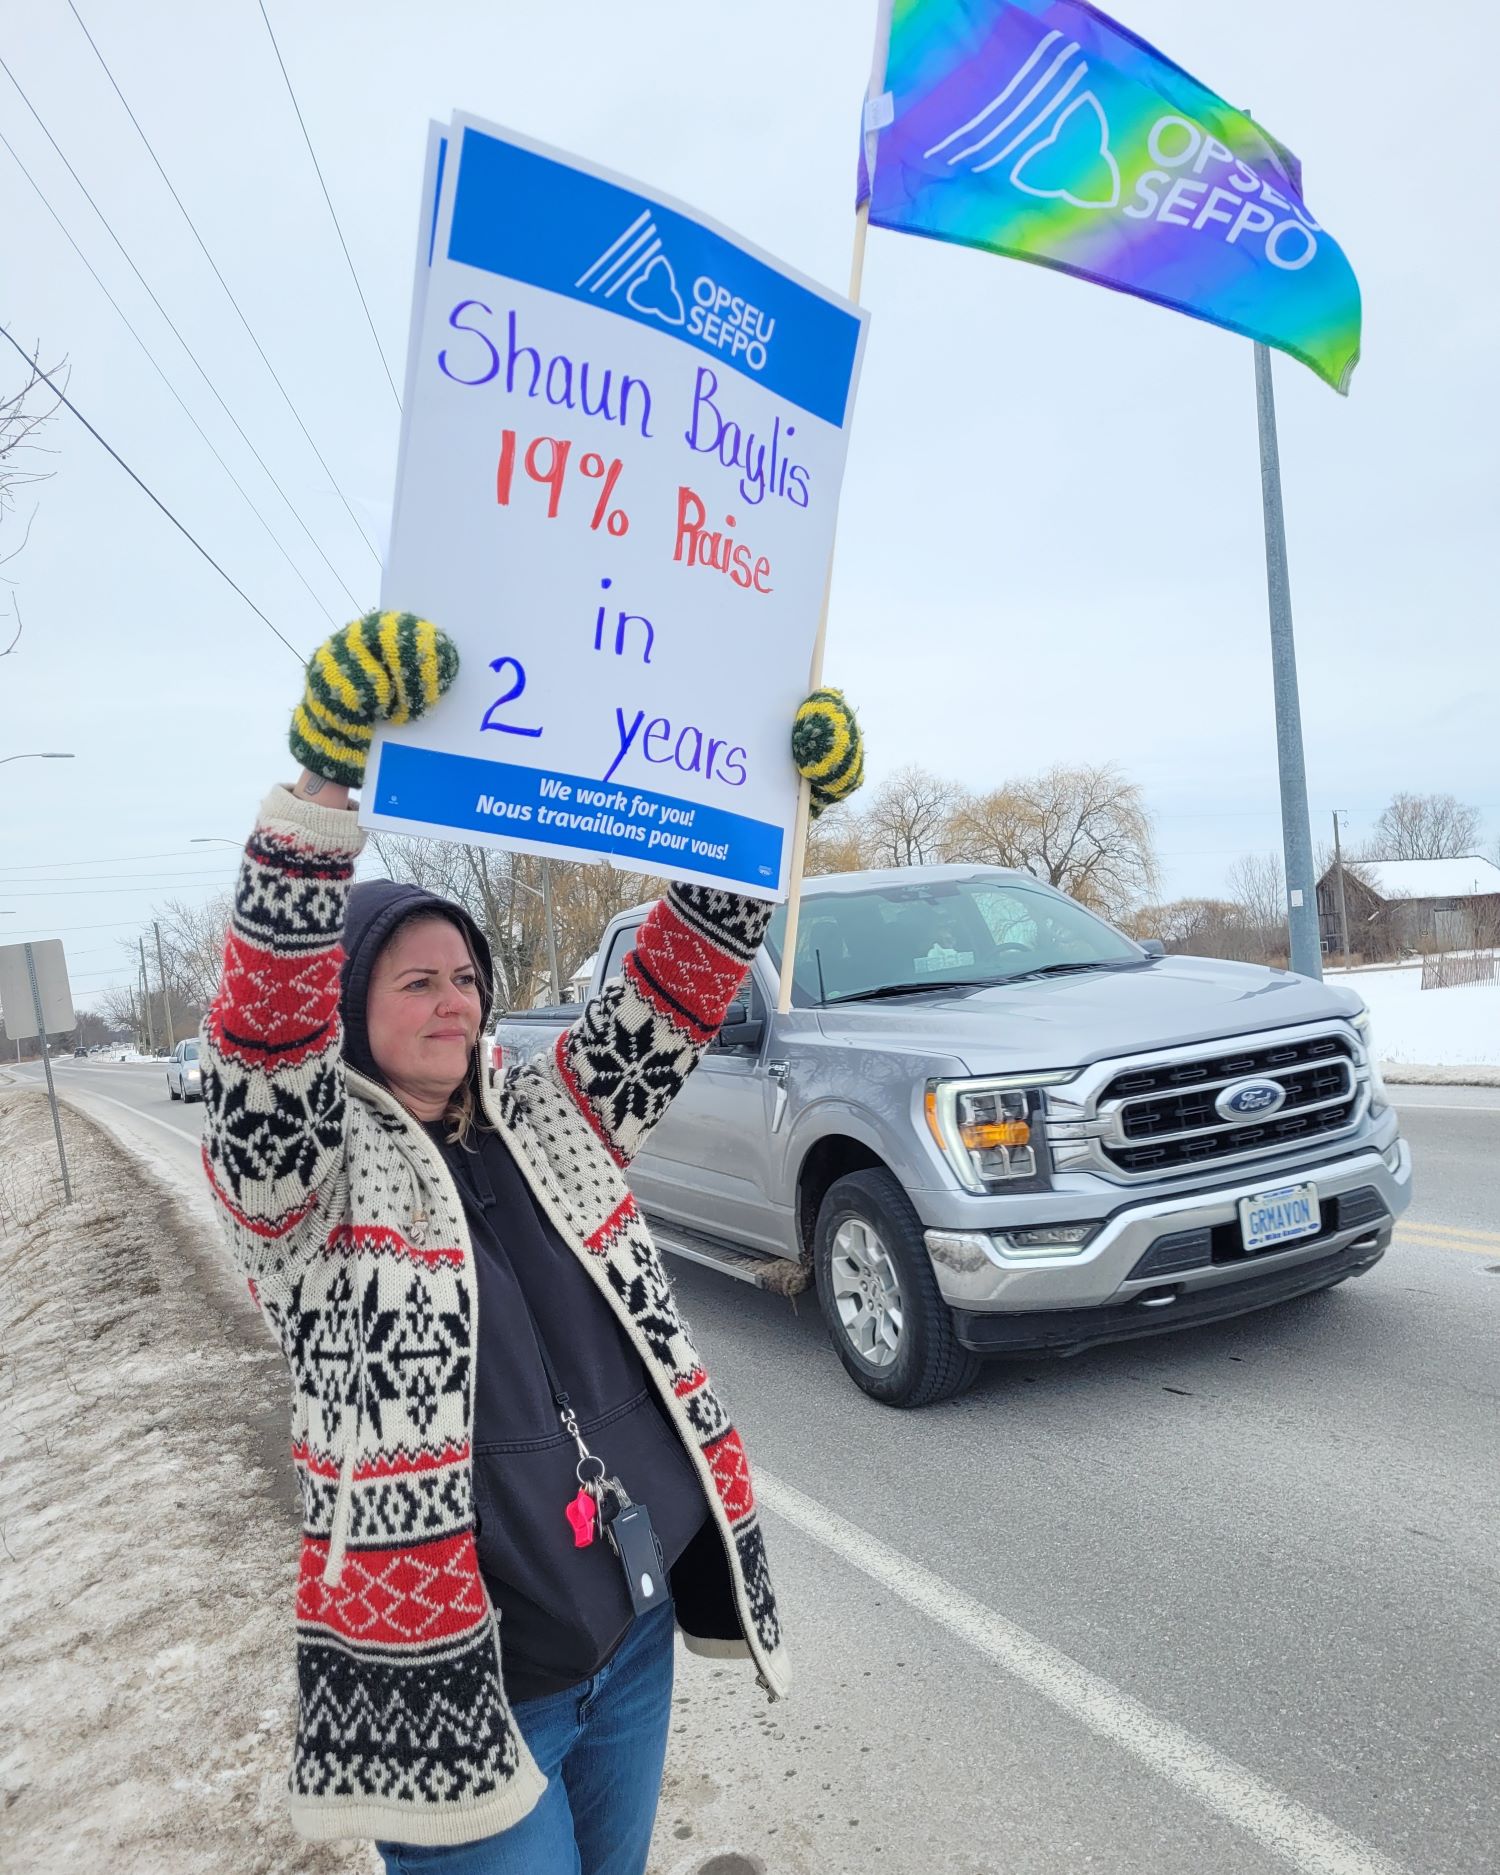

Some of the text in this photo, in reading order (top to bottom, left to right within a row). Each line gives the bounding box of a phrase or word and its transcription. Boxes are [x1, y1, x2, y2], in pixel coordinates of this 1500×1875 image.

[1122, 170, 1317, 270] SEFPO
[687, 305, 767, 371] SEFPO
[693, 276, 776, 343] OPSEU
[437, 300, 811, 508] Shaun Baylis
[497, 430, 774, 594] 19% Raise
[594, 577, 655, 664] in
[480, 656, 747, 787] 2 years
[475, 794, 729, 861] Nous travaillons pour vous!
[539, 778, 696, 828] We work for you!
[1239, 1090, 1271, 1110] Ford
